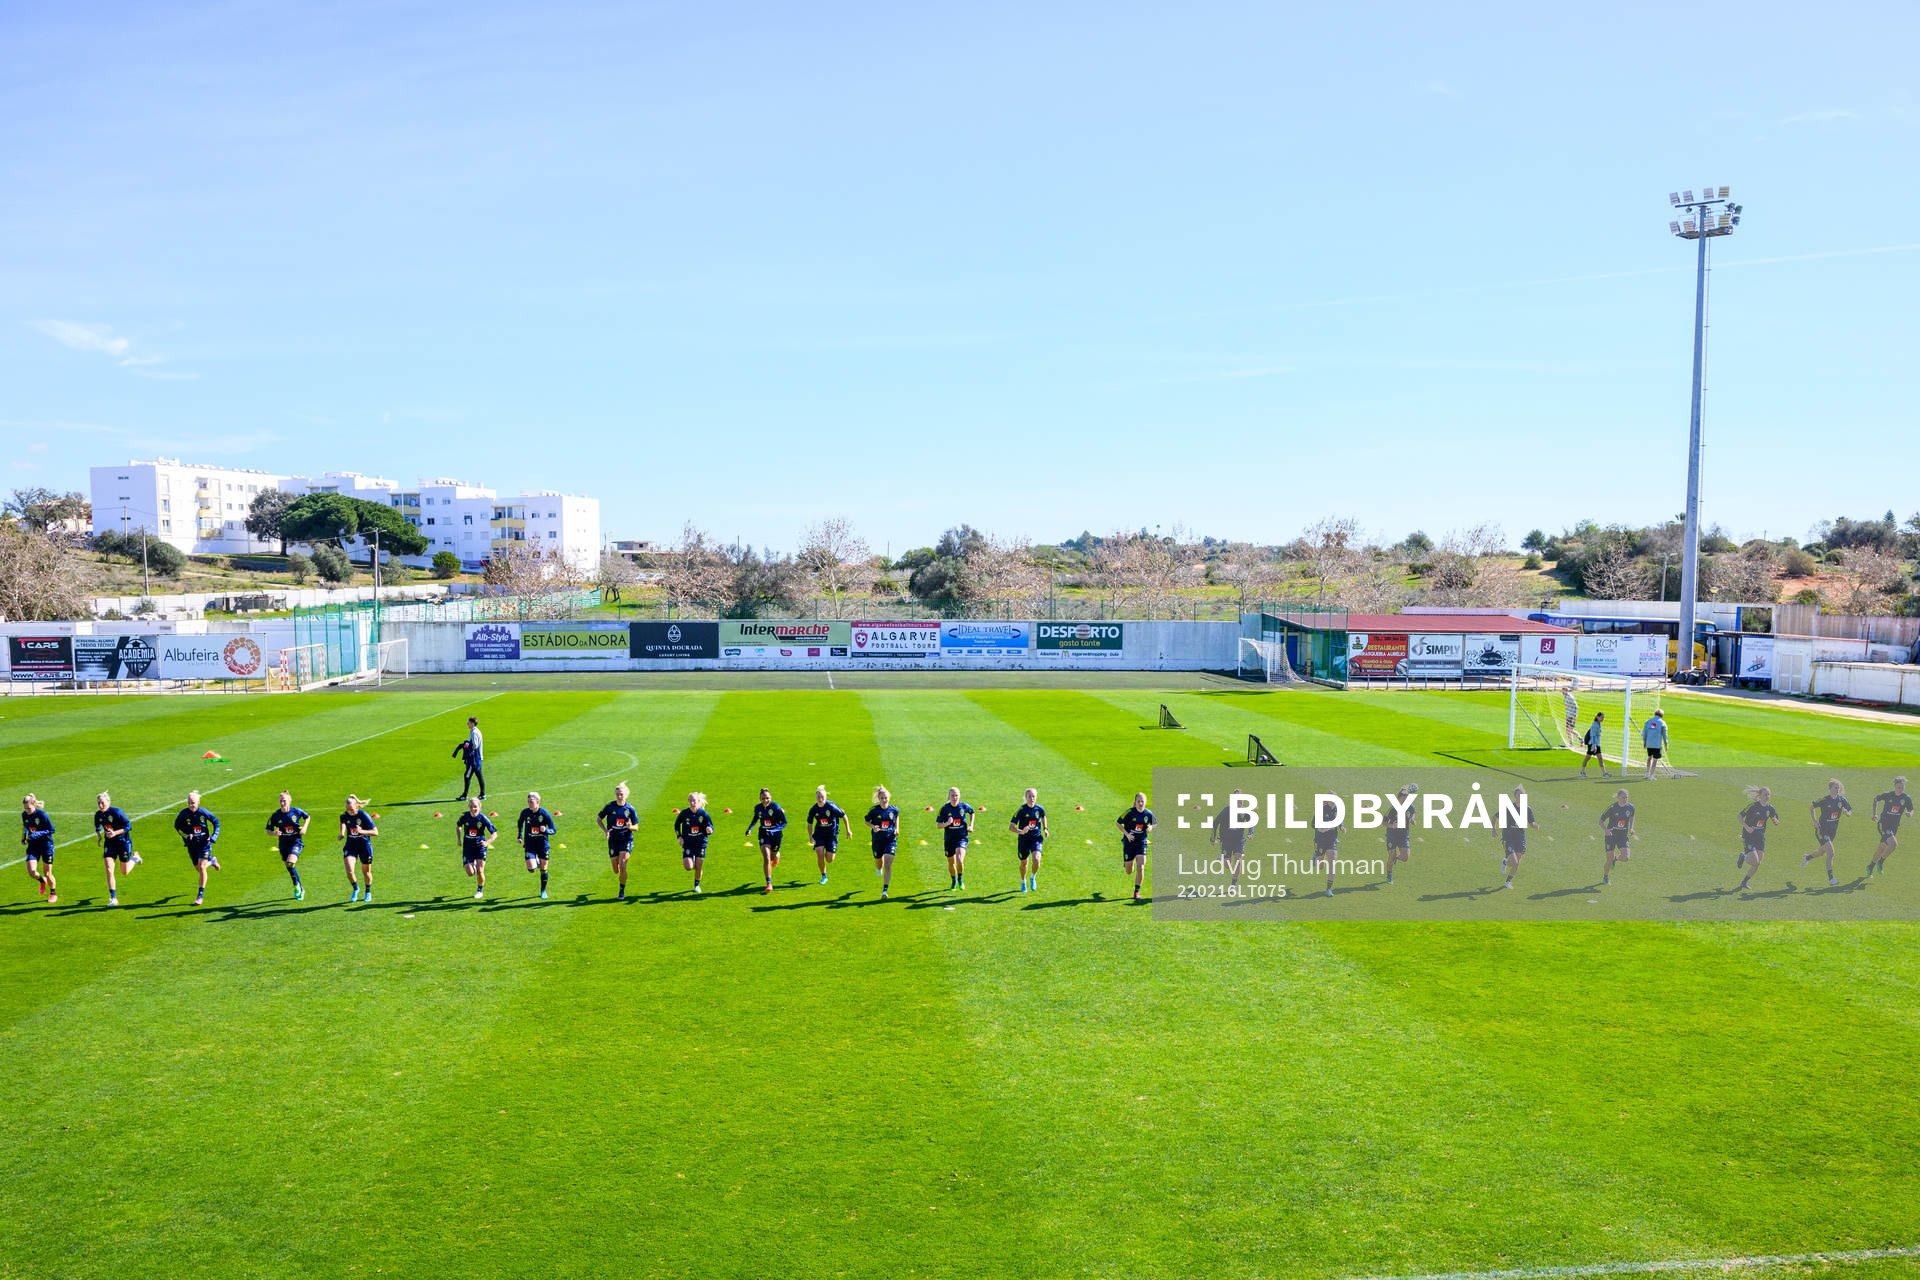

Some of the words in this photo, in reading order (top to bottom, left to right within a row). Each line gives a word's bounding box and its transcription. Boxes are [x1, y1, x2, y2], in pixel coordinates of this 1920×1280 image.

[871, 631, 937, 641] ALGARVE
[1040, 626, 1120, 638] DESPRTO
[523, 632, 579, 647] ESTÁDIO
[588, 634, 627, 647] NORA
[1595, 639, 1618, 649] RCM
[118, 648, 156, 660] ACADEMIA
[164, 647, 220, 662] Albufeira
[1426, 645, 1461, 655] SIMPLY
[1534, 656, 1560, 666] Luna
